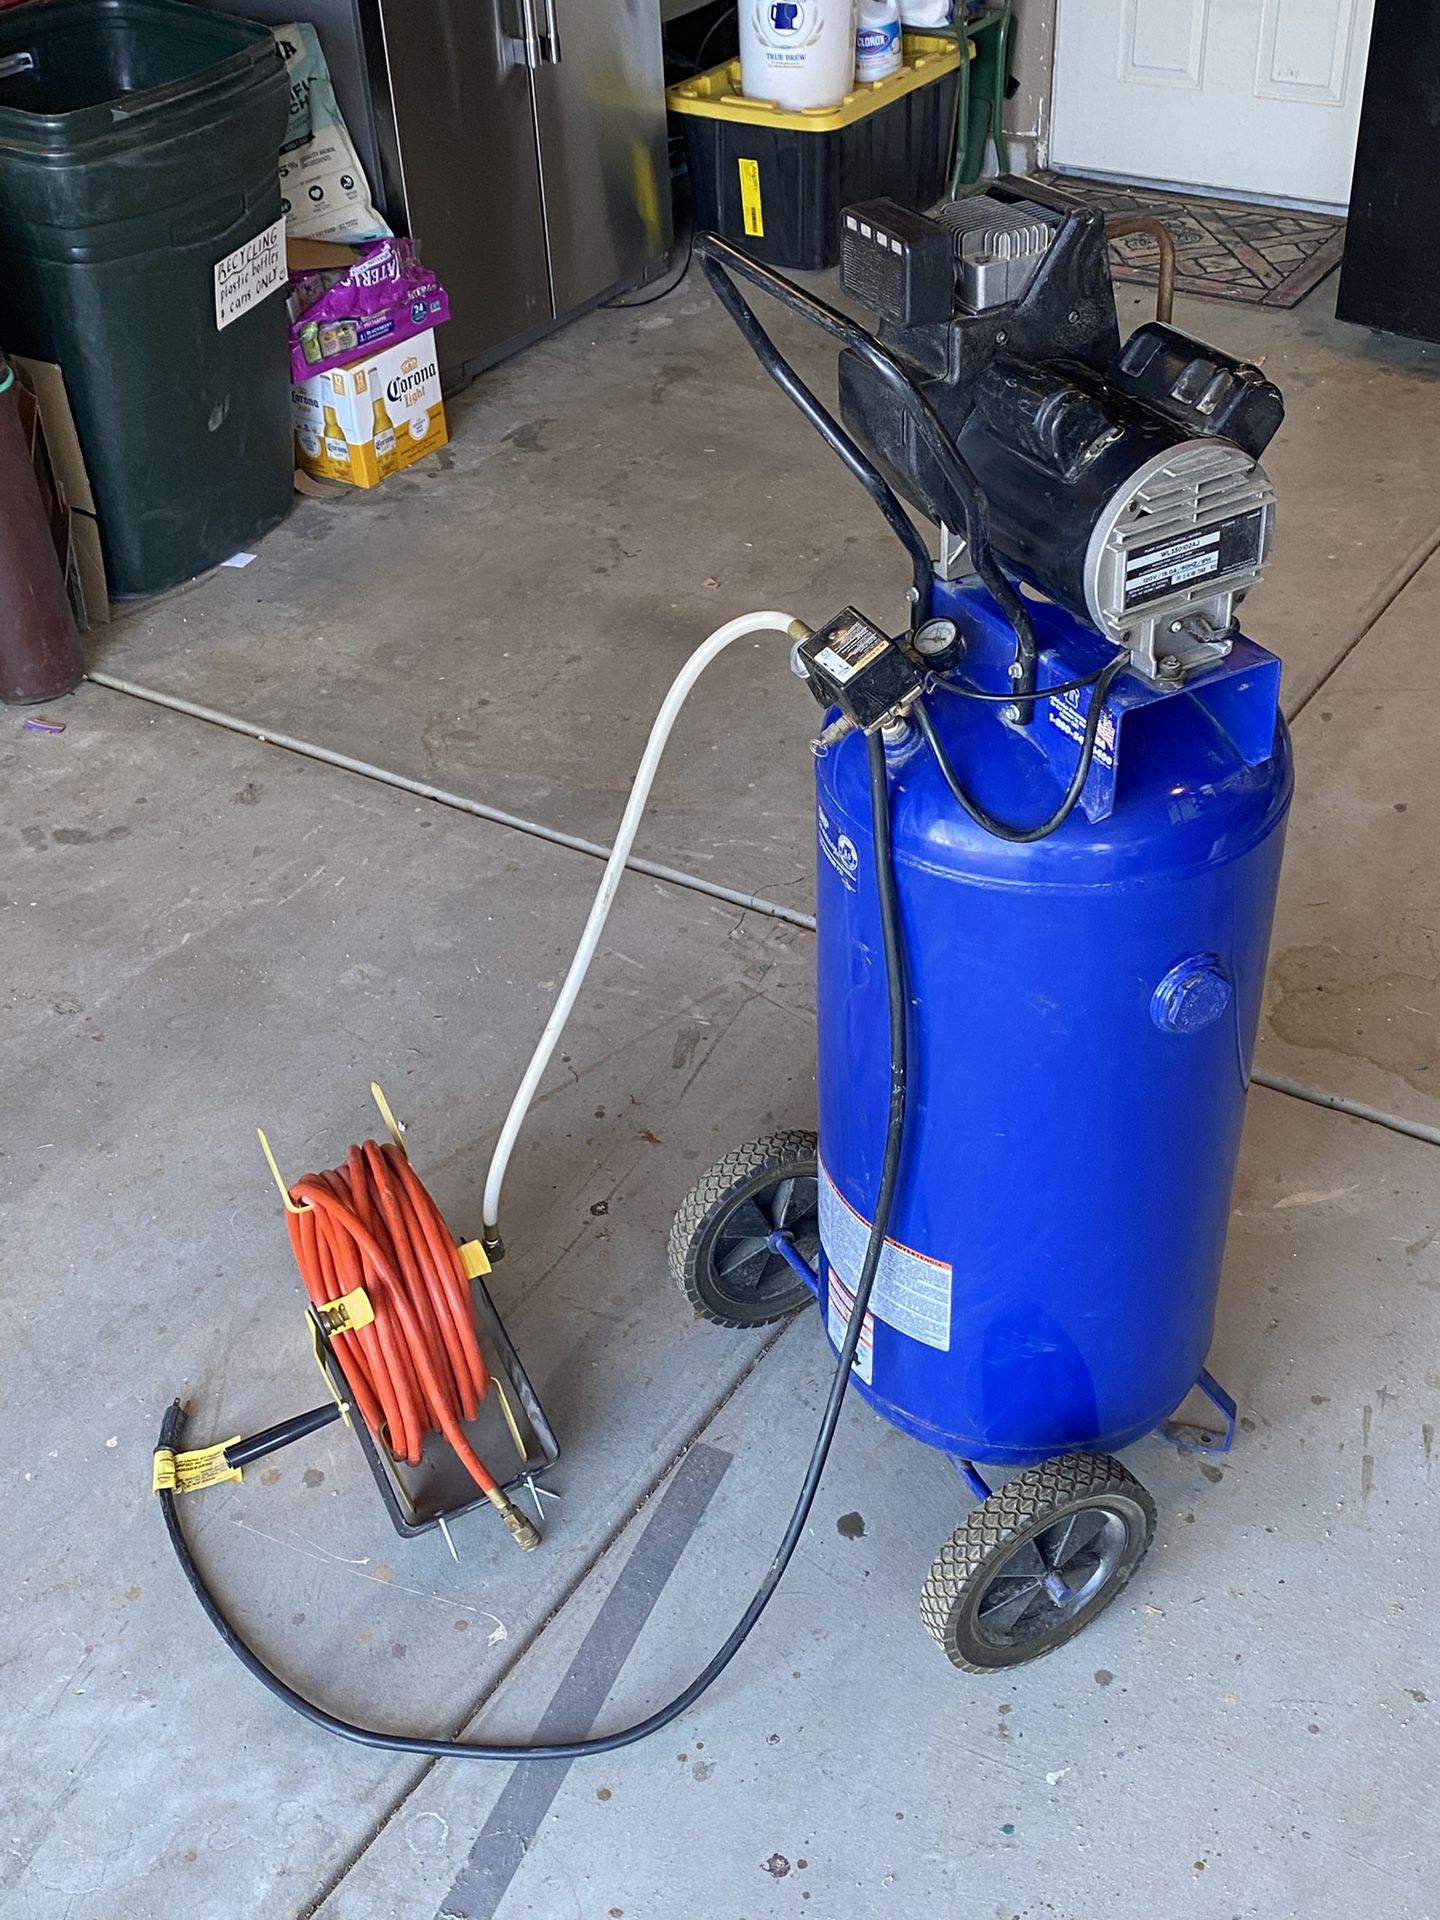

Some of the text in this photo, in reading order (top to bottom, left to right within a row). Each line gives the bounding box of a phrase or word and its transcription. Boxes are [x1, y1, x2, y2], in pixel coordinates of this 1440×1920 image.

[857, 35, 885, 48] CLOROX
[766, 53, 807, 61] TRUE BREW
[218, 227, 277, 282] RECYCLING
[220, 248, 279, 303] plastic bottles
[229, 289, 252, 313] cans
[256, 265, 278, 294] ONLY
[413, 302, 424, 314] 24
[334, 374, 342, 385] 12
[387, 363, 436, 402] Corona
[291, 391, 319, 408] Corona
[403, 386, 426, 408] Light
[376, 435, 395, 450] Corona
[892, 1241, 943, 1268] ADVERTENCIA
